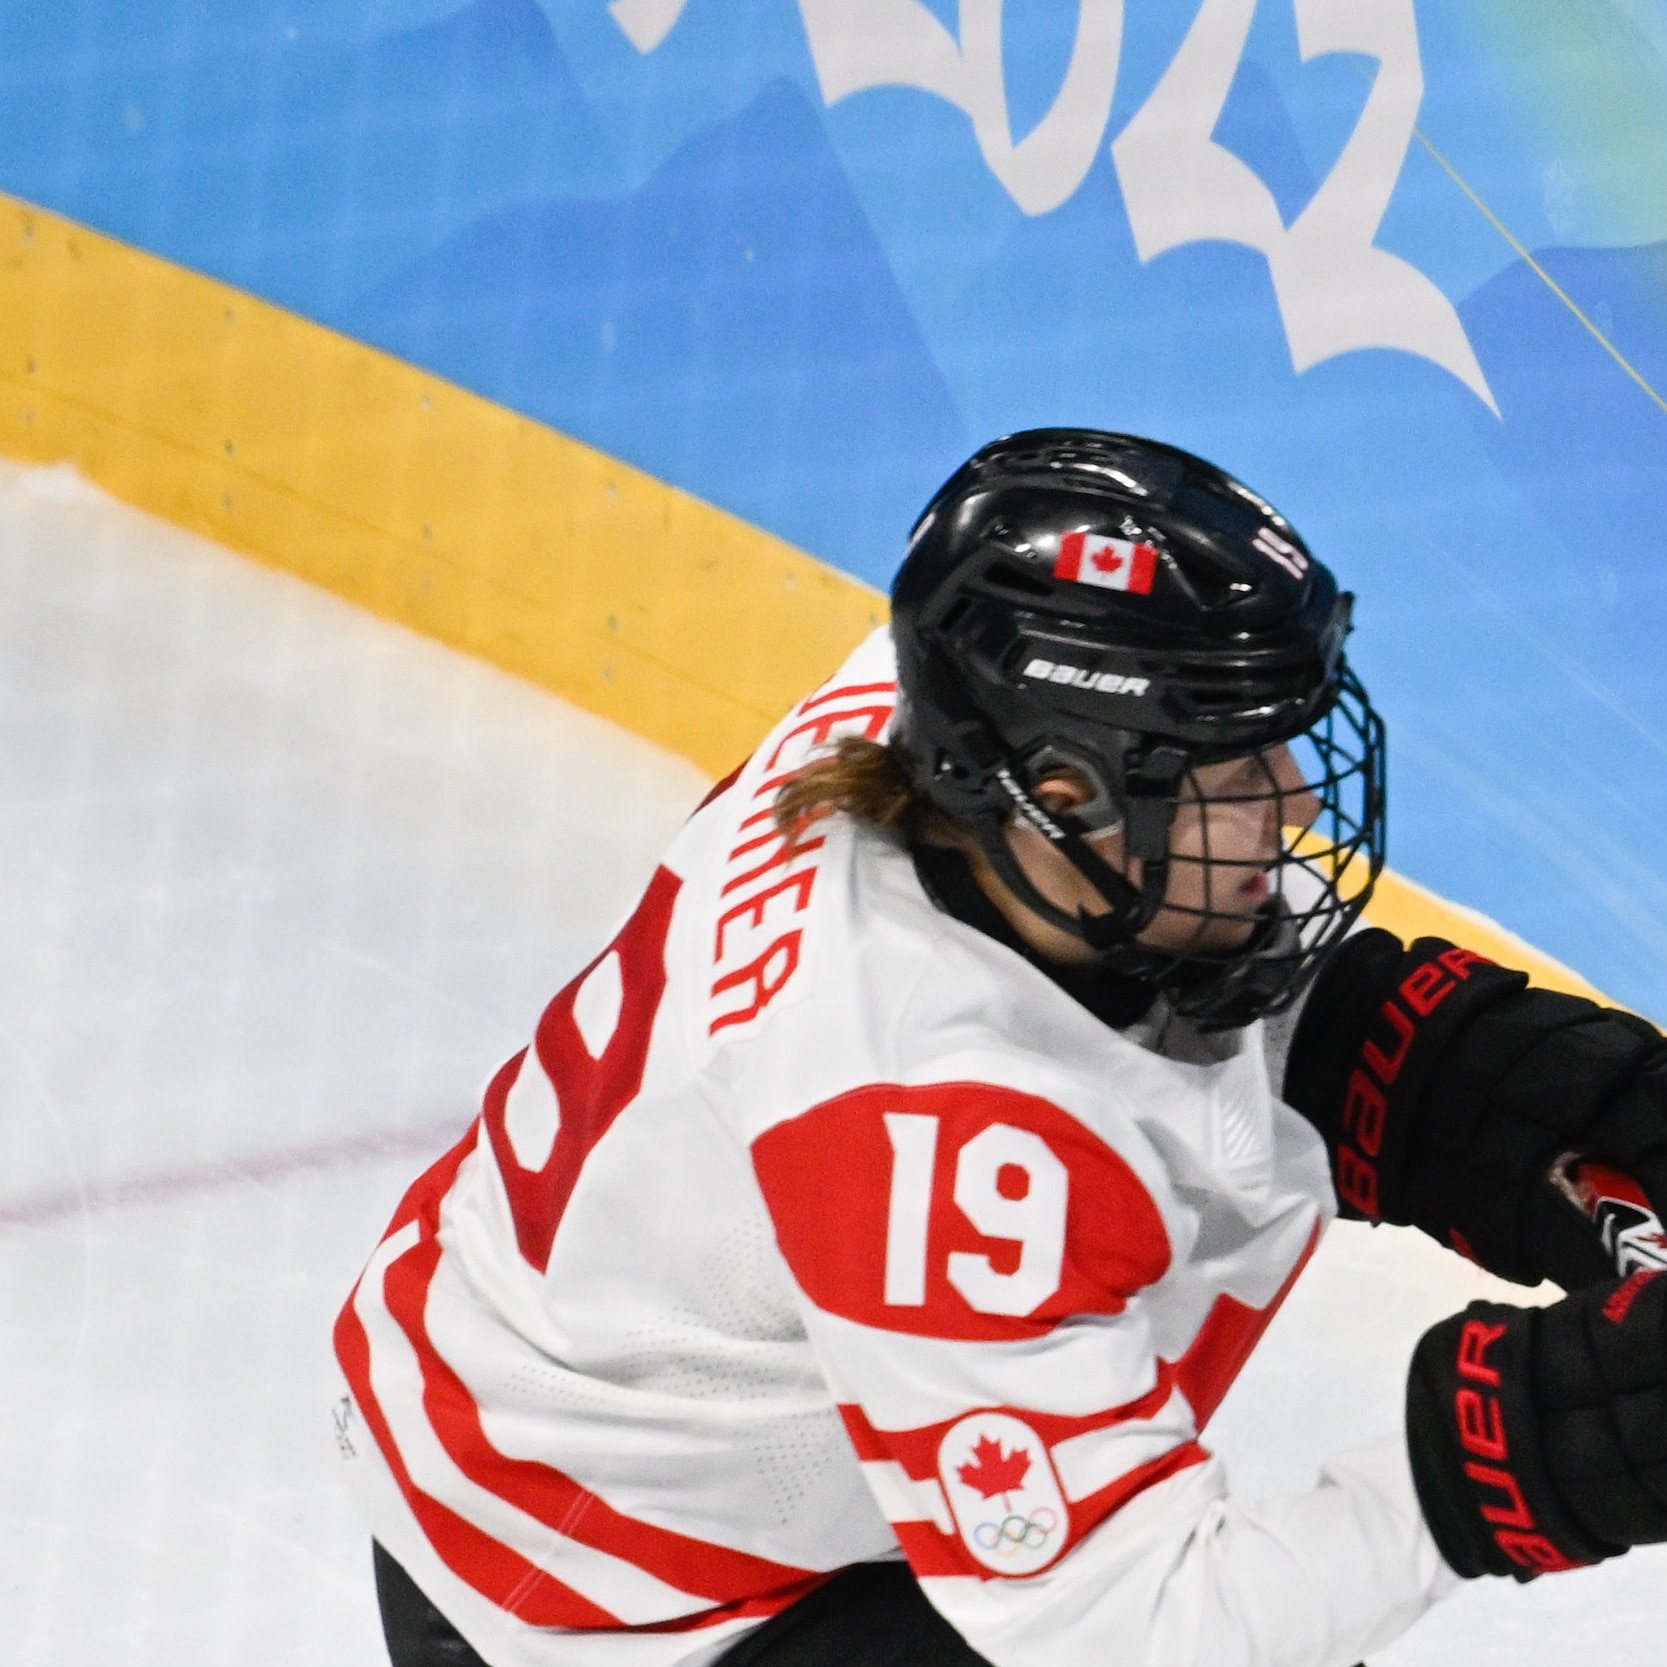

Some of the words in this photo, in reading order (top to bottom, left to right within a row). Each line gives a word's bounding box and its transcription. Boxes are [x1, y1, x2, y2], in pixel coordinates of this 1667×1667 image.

[1023, 658, 1150, 698] BAUER
[483, 862, 684, 1275] 9
[882, 1110, 1070, 1319] 19
[1456, 1320, 1596, 1574] AUER
